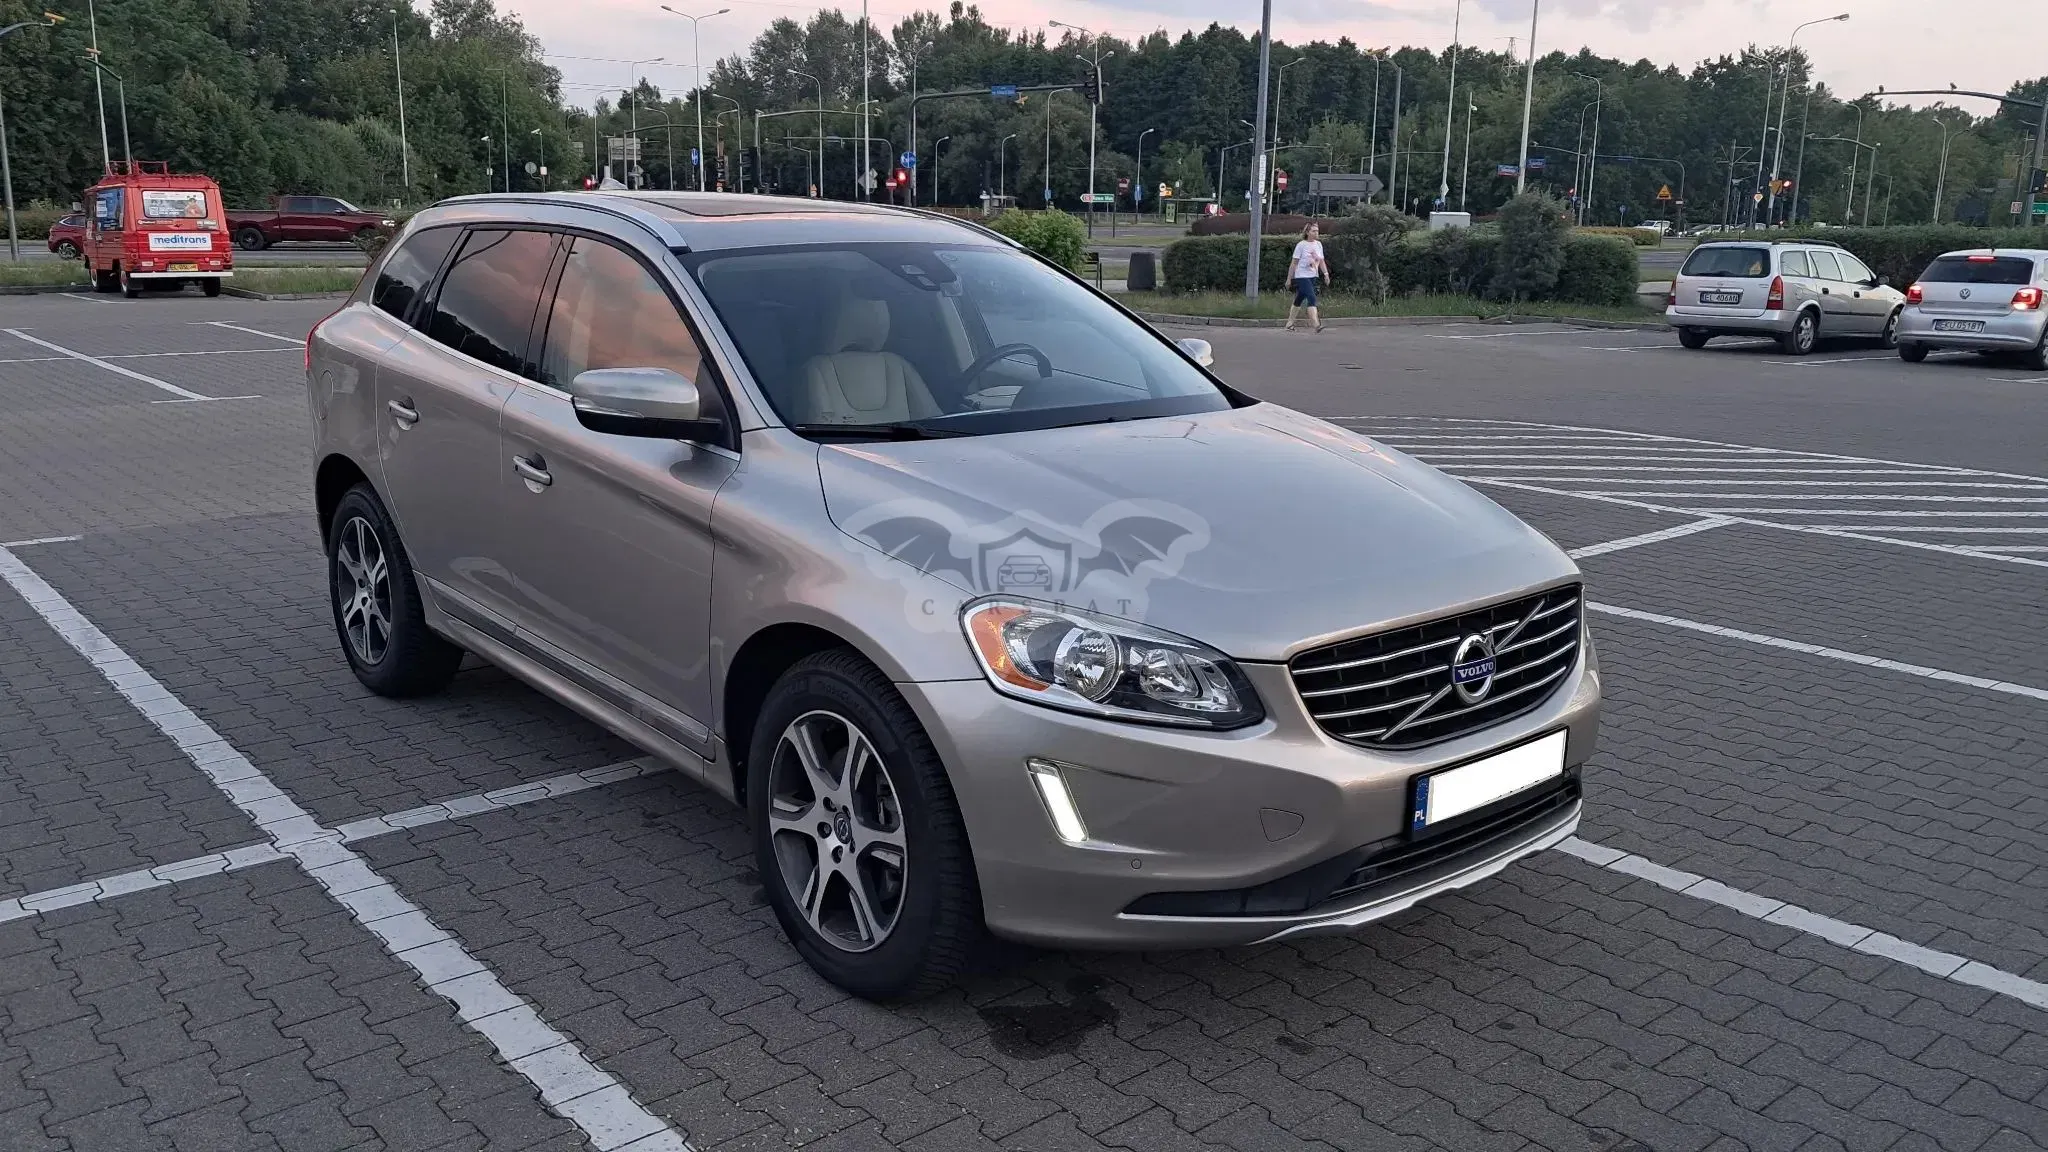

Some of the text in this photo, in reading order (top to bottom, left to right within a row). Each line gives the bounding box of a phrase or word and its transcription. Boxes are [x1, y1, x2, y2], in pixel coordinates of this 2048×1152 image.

[154, 235, 207, 244] meditrans
[1458, 662, 1494, 678] VOLVO
[1414, 809, 1425, 822] PL
